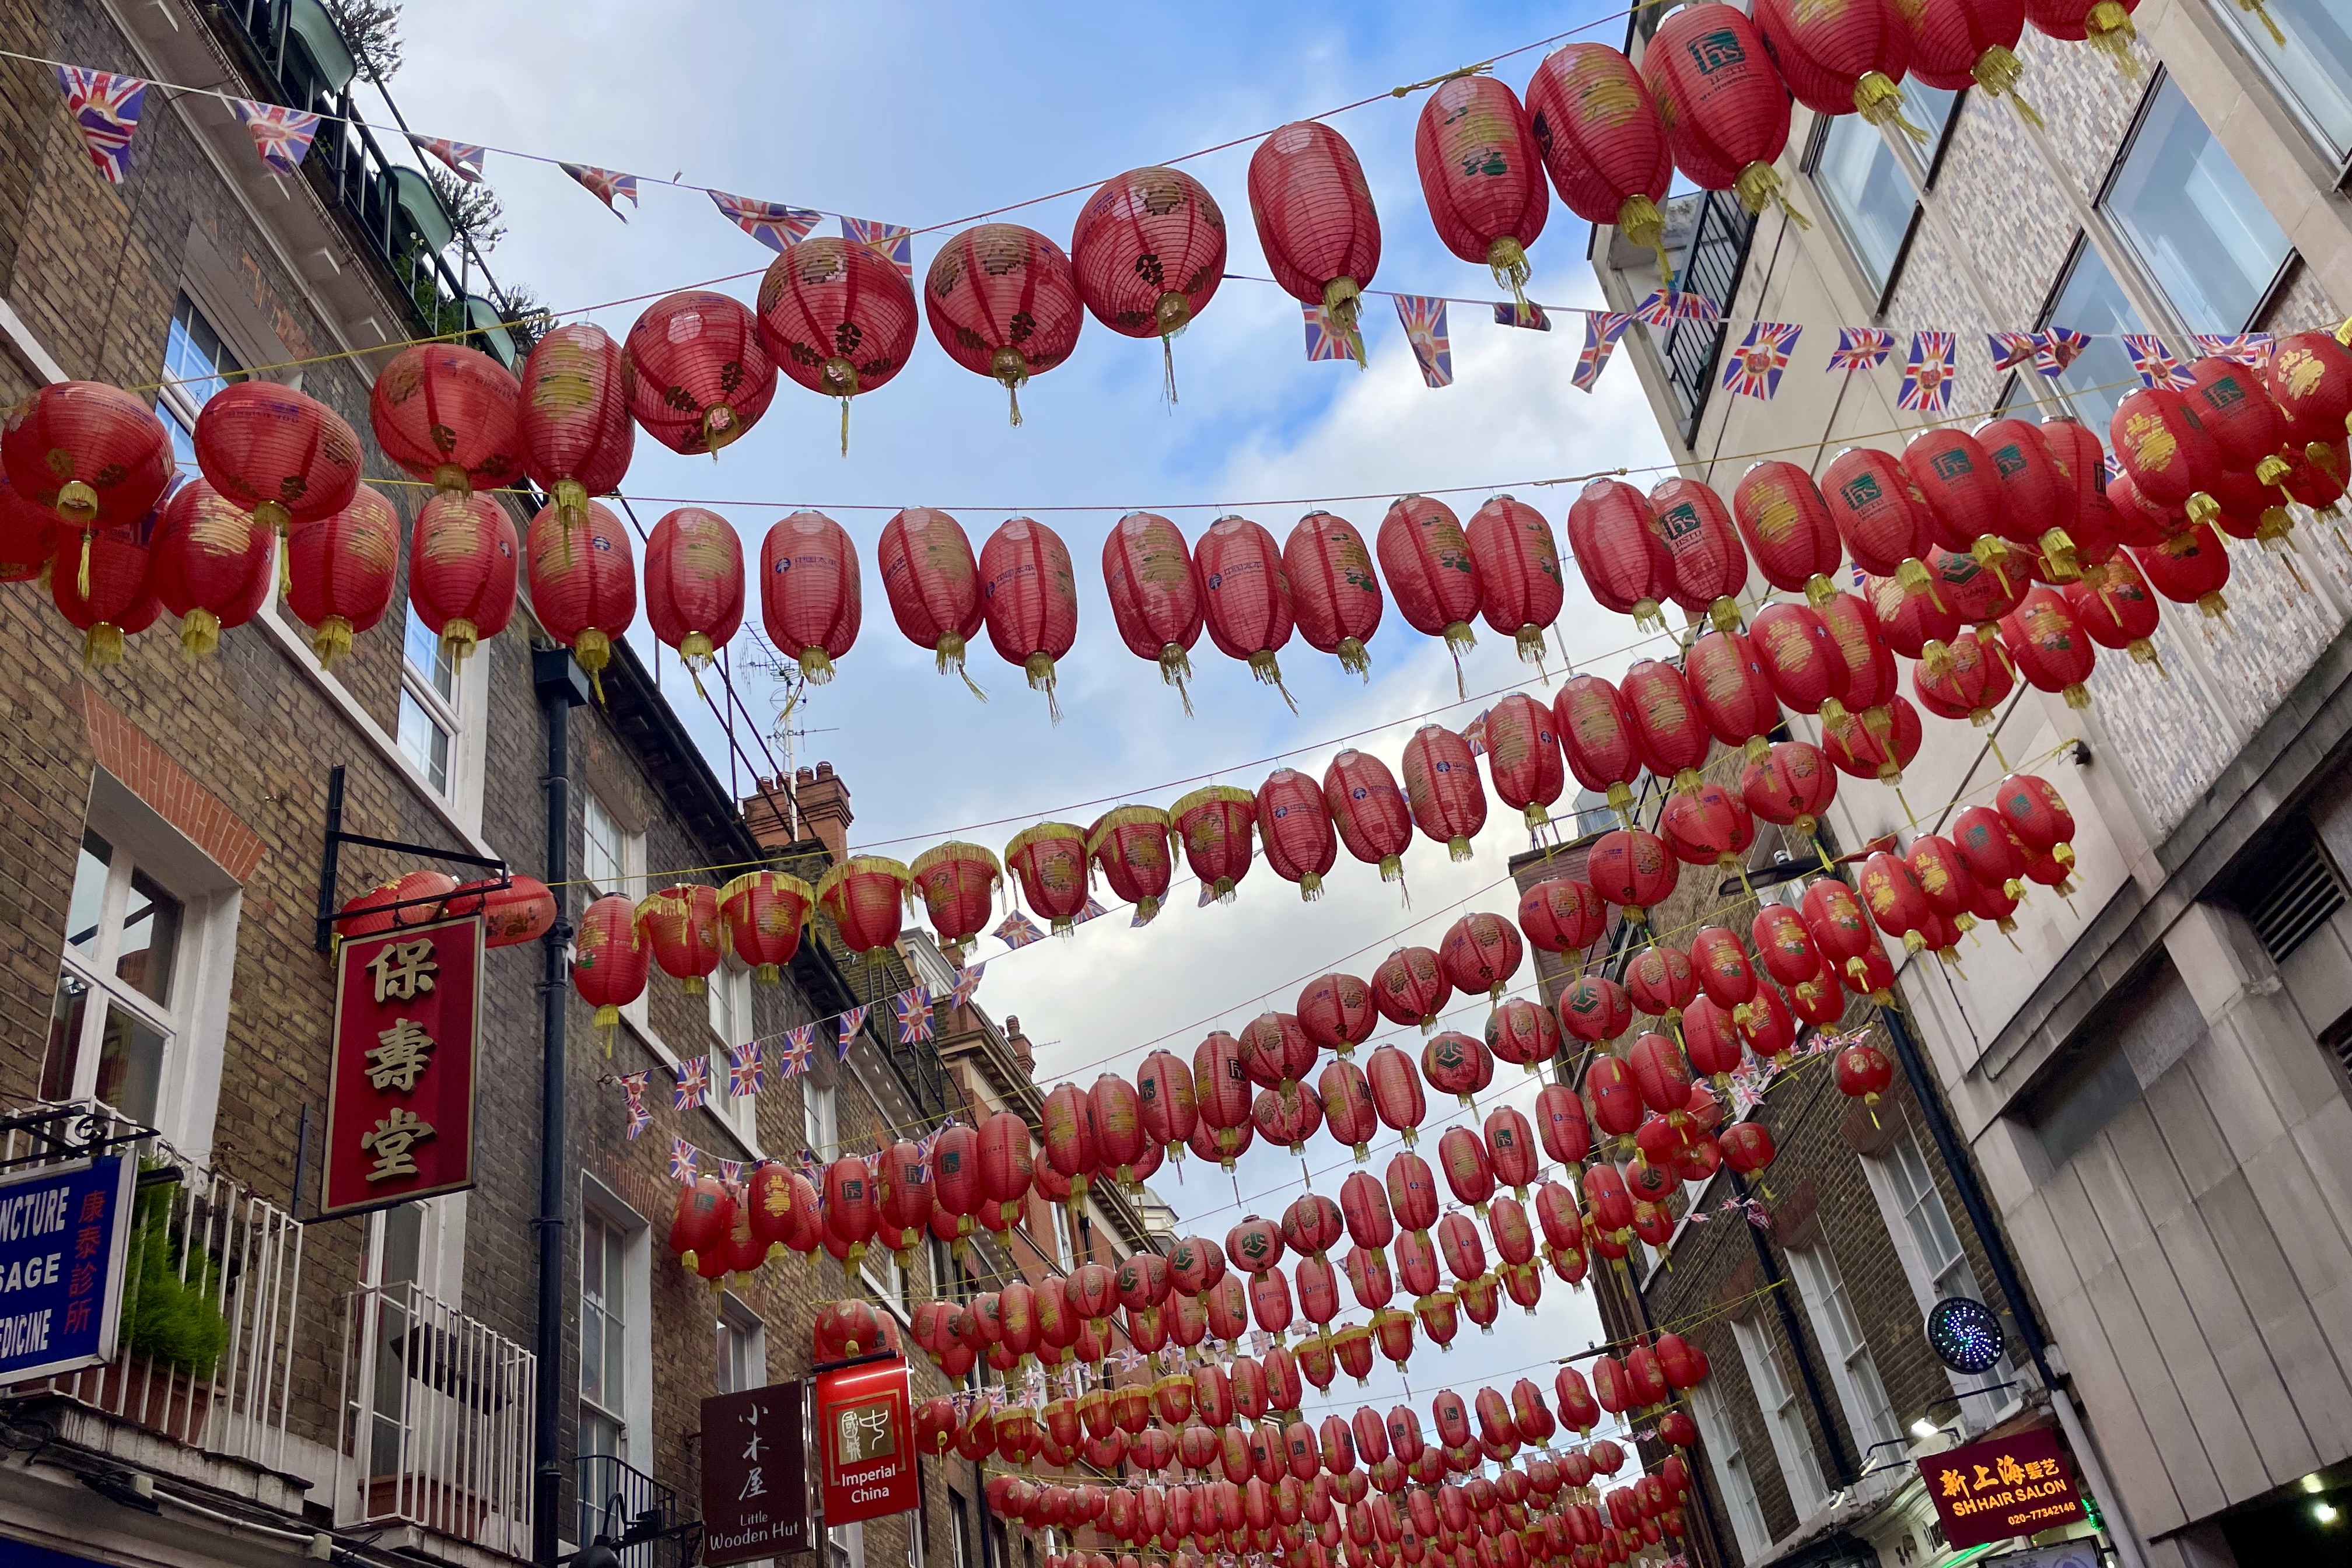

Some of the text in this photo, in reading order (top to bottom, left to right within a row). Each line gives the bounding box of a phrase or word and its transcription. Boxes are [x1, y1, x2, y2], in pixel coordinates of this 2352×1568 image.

[361, 937, 438, 1182] 保壽堂
[63, 1190, 106, 1335] 康泰診所
[738, 1402, 771, 1502] 小木屋
[842, 1464, 896, 1488] Imperial
[851, 1487, 890, 1504] China
[1977, 1492, 2015, 1510] HAIR
[2015, 1479, 2067, 1502] SALON
[740, 1510, 768, 1527] Little
[710, 1520, 799, 1551] Wooden Hut
